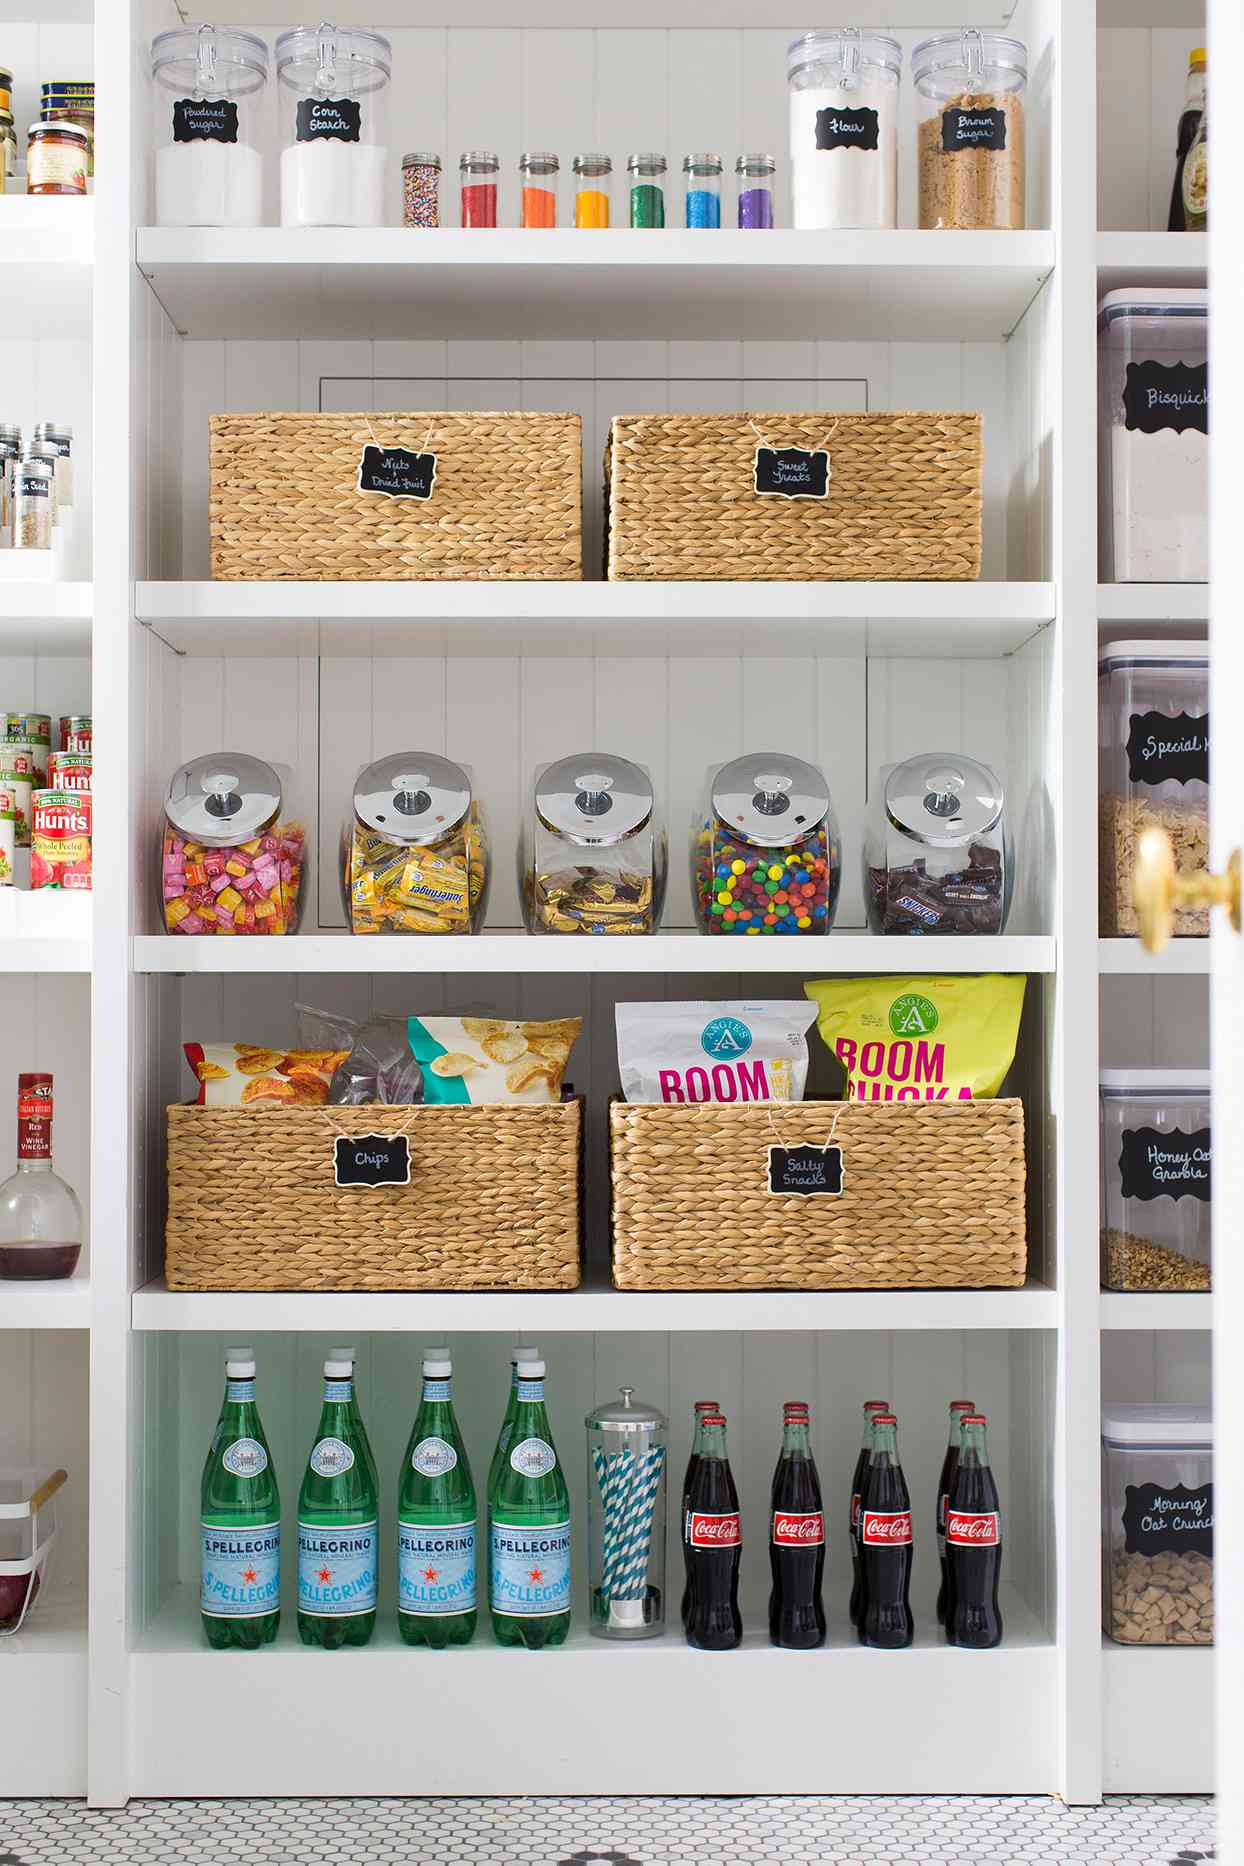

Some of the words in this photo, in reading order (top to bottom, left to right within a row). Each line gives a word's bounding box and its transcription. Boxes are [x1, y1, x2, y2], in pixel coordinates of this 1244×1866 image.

[312, 105, 341, 117] Corn
[310, 119, 350, 131] Starch
[829, 117, 865, 134] Flour
[957, 115, 995, 128] Brown
[381, 458, 409, 470] Nuts
[777, 460, 808, 472] Sweet
[371, 475, 400, 488] Dried
[773, 471, 810, 484] Treats
[1142, 736, 1202, 760] Special
[35, 811, 88, 832] Hunt's
[836, 1037, 945, 1083] BOOM
[659, 1060, 770, 1103] BOOM
[355, 1152, 389, 1169] Chips
[1148, 1145, 1191, 1170] Honey
[787, 1158, 824, 1177] Salty
[1153, 1166, 1208, 1182] Granola
[783, 1173, 826, 1185] Snacks
[1149, 1496, 1207, 1516] Morning
[695, 1519, 738, 1538] Coca-Cola
[777, 1519, 821, 1537] Coca-Cola
[867, 1518, 910, 1537] Coca-Cola
[949, 1517, 992, 1537] Coca-Cola
[1141, 1516, 1167, 1531] Oat
